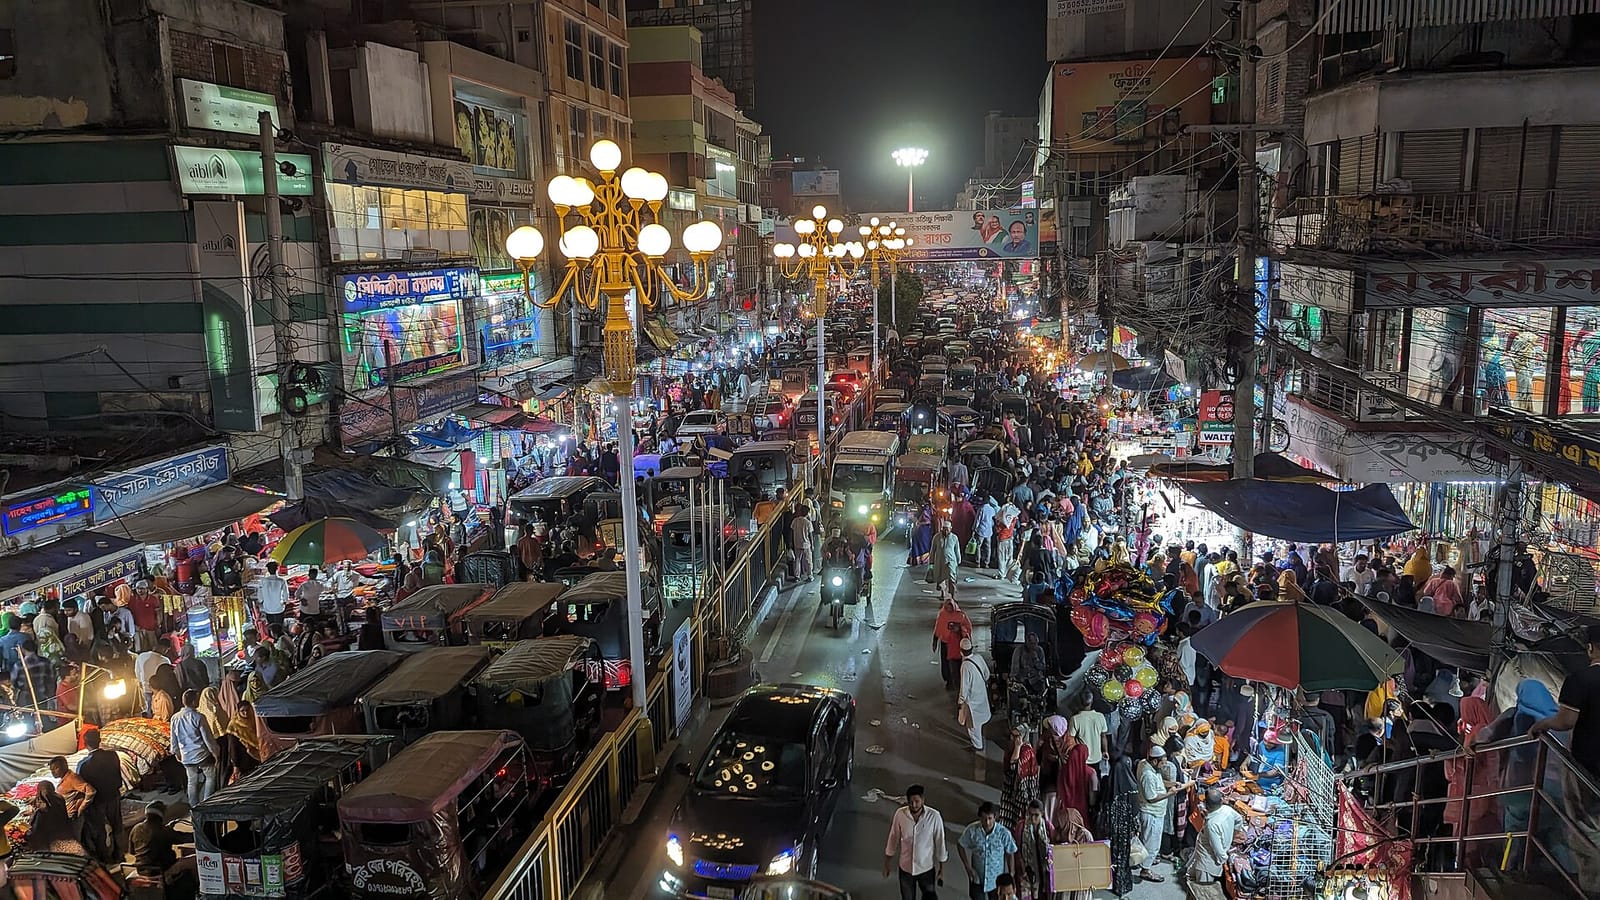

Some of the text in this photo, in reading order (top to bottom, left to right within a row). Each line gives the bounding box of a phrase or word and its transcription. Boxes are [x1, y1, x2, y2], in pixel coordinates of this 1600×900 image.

[189, 160, 208, 180] aibl
[923, 233, 952, 246] স্বাগত
[1204, 433, 1234, 441] WALTO
[155, 454, 220, 486] ক্রোকারীজ
[63, 559, 137, 594] সাহেব আলী শাড়ী ঘর
[394, 615, 427, 629] VIP
[352, 863, 373, 889] ভাই
